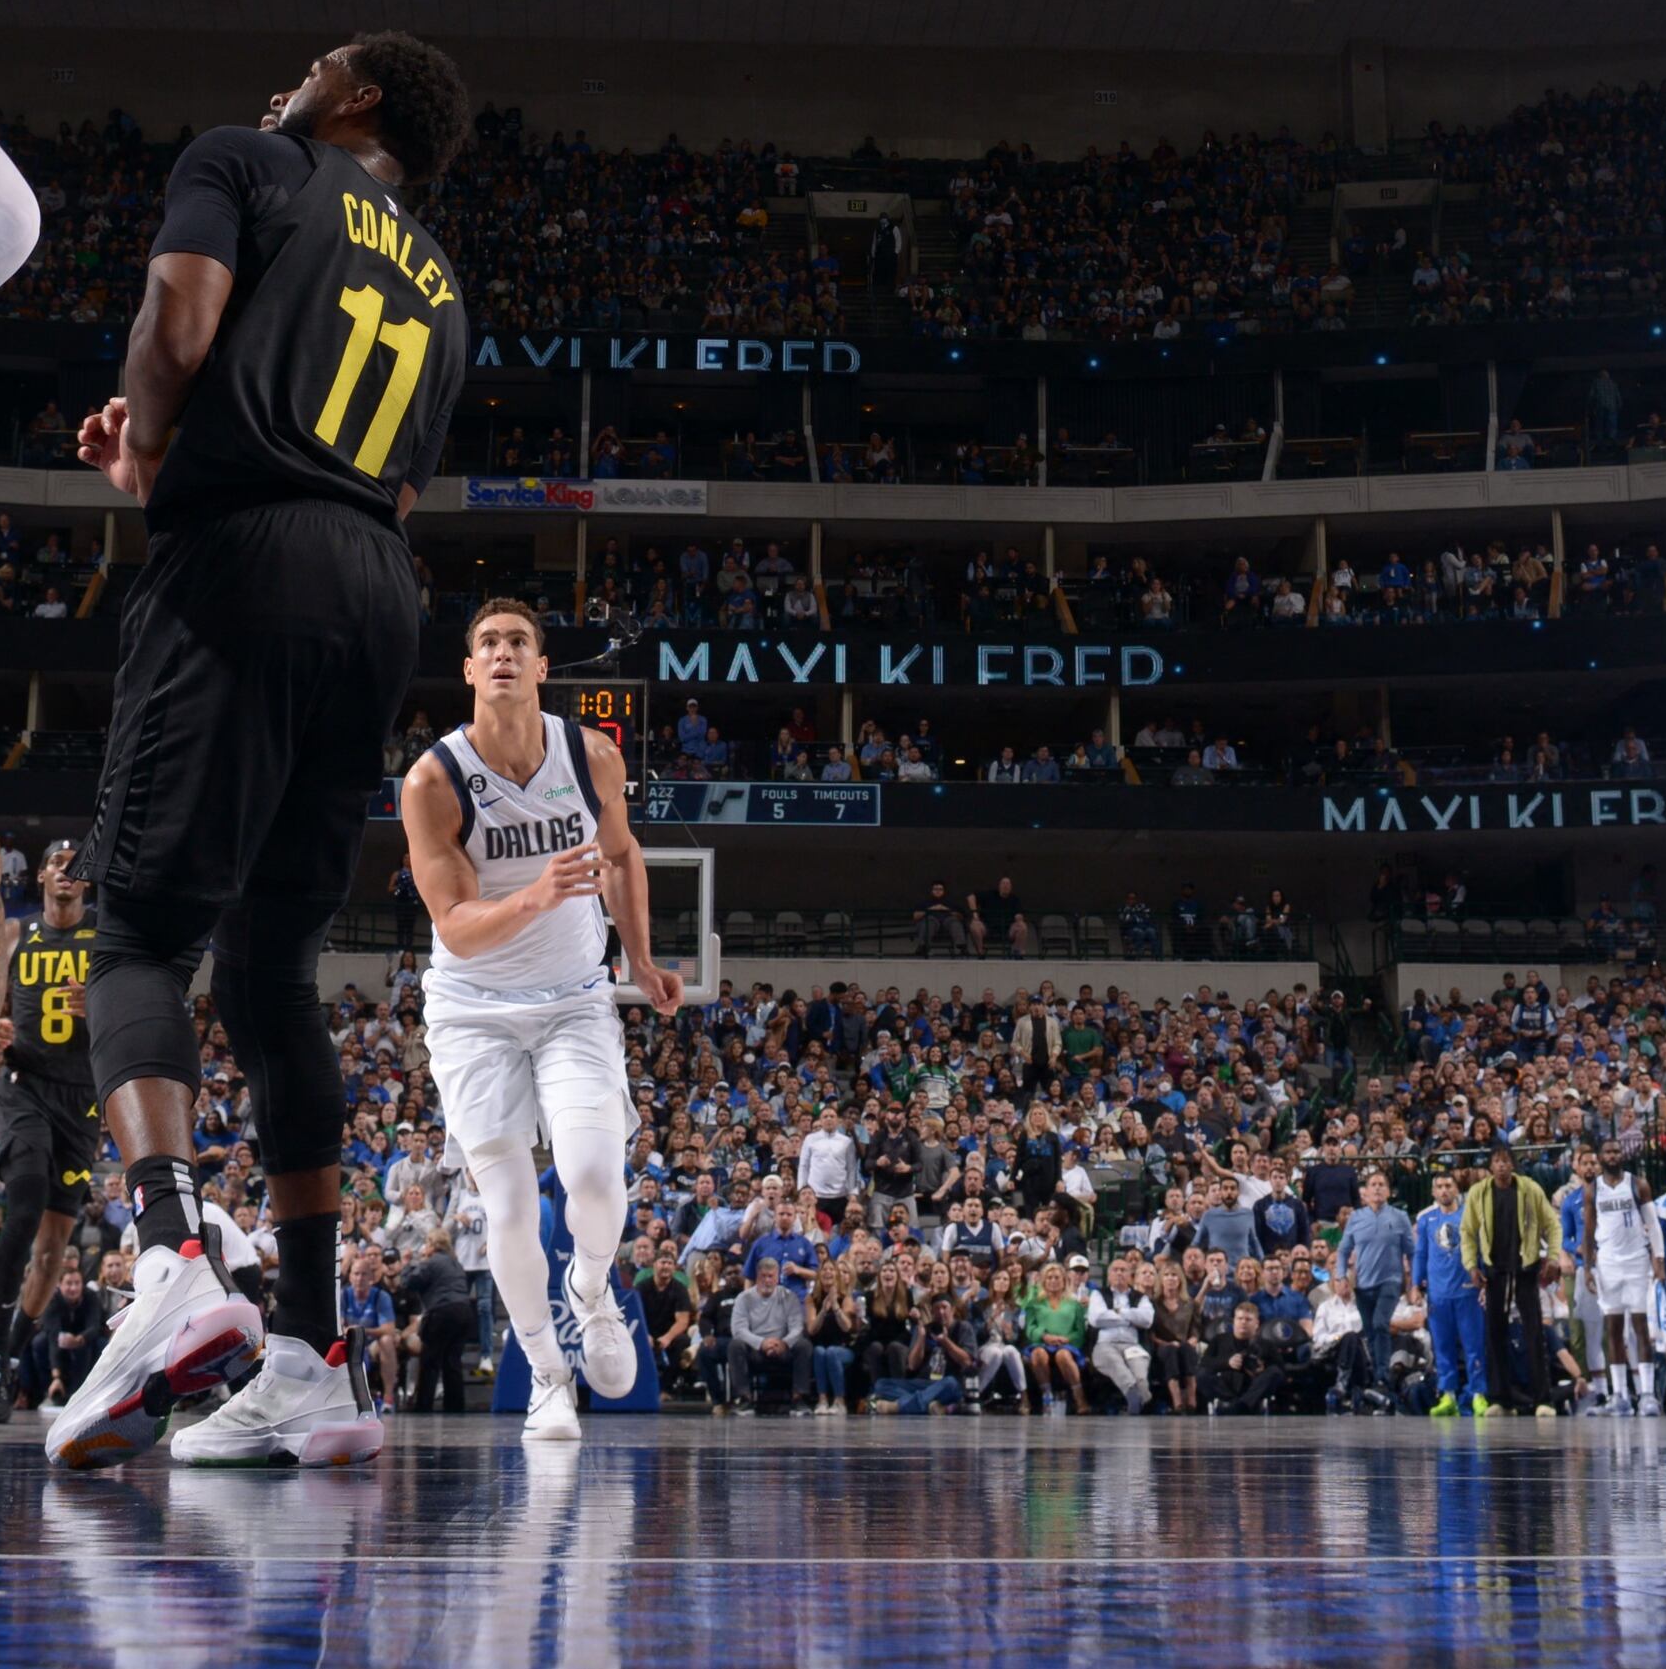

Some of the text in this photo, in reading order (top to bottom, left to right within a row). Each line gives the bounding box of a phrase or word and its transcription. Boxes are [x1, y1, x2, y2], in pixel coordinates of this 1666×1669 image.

[1095, 92, 1117, 103] 319
[342, 191, 455, 309] CONLEY
[314, 283, 431, 480] 11
[604, 487, 703, 507] LOUNGE
[579, 690, 632, 719] 1:01
[544, 784, 575, 801] chime
[649, 787, 674, 798] AZZ
[761, 789, 870, 801] FOULS TIMEOUTS
[648, 801, 670, 819] 47
[773, 803, 845, 820] 5 7
[484, 811, 585, 861] DALLAS
[40, 986, 74, 1044] 8
